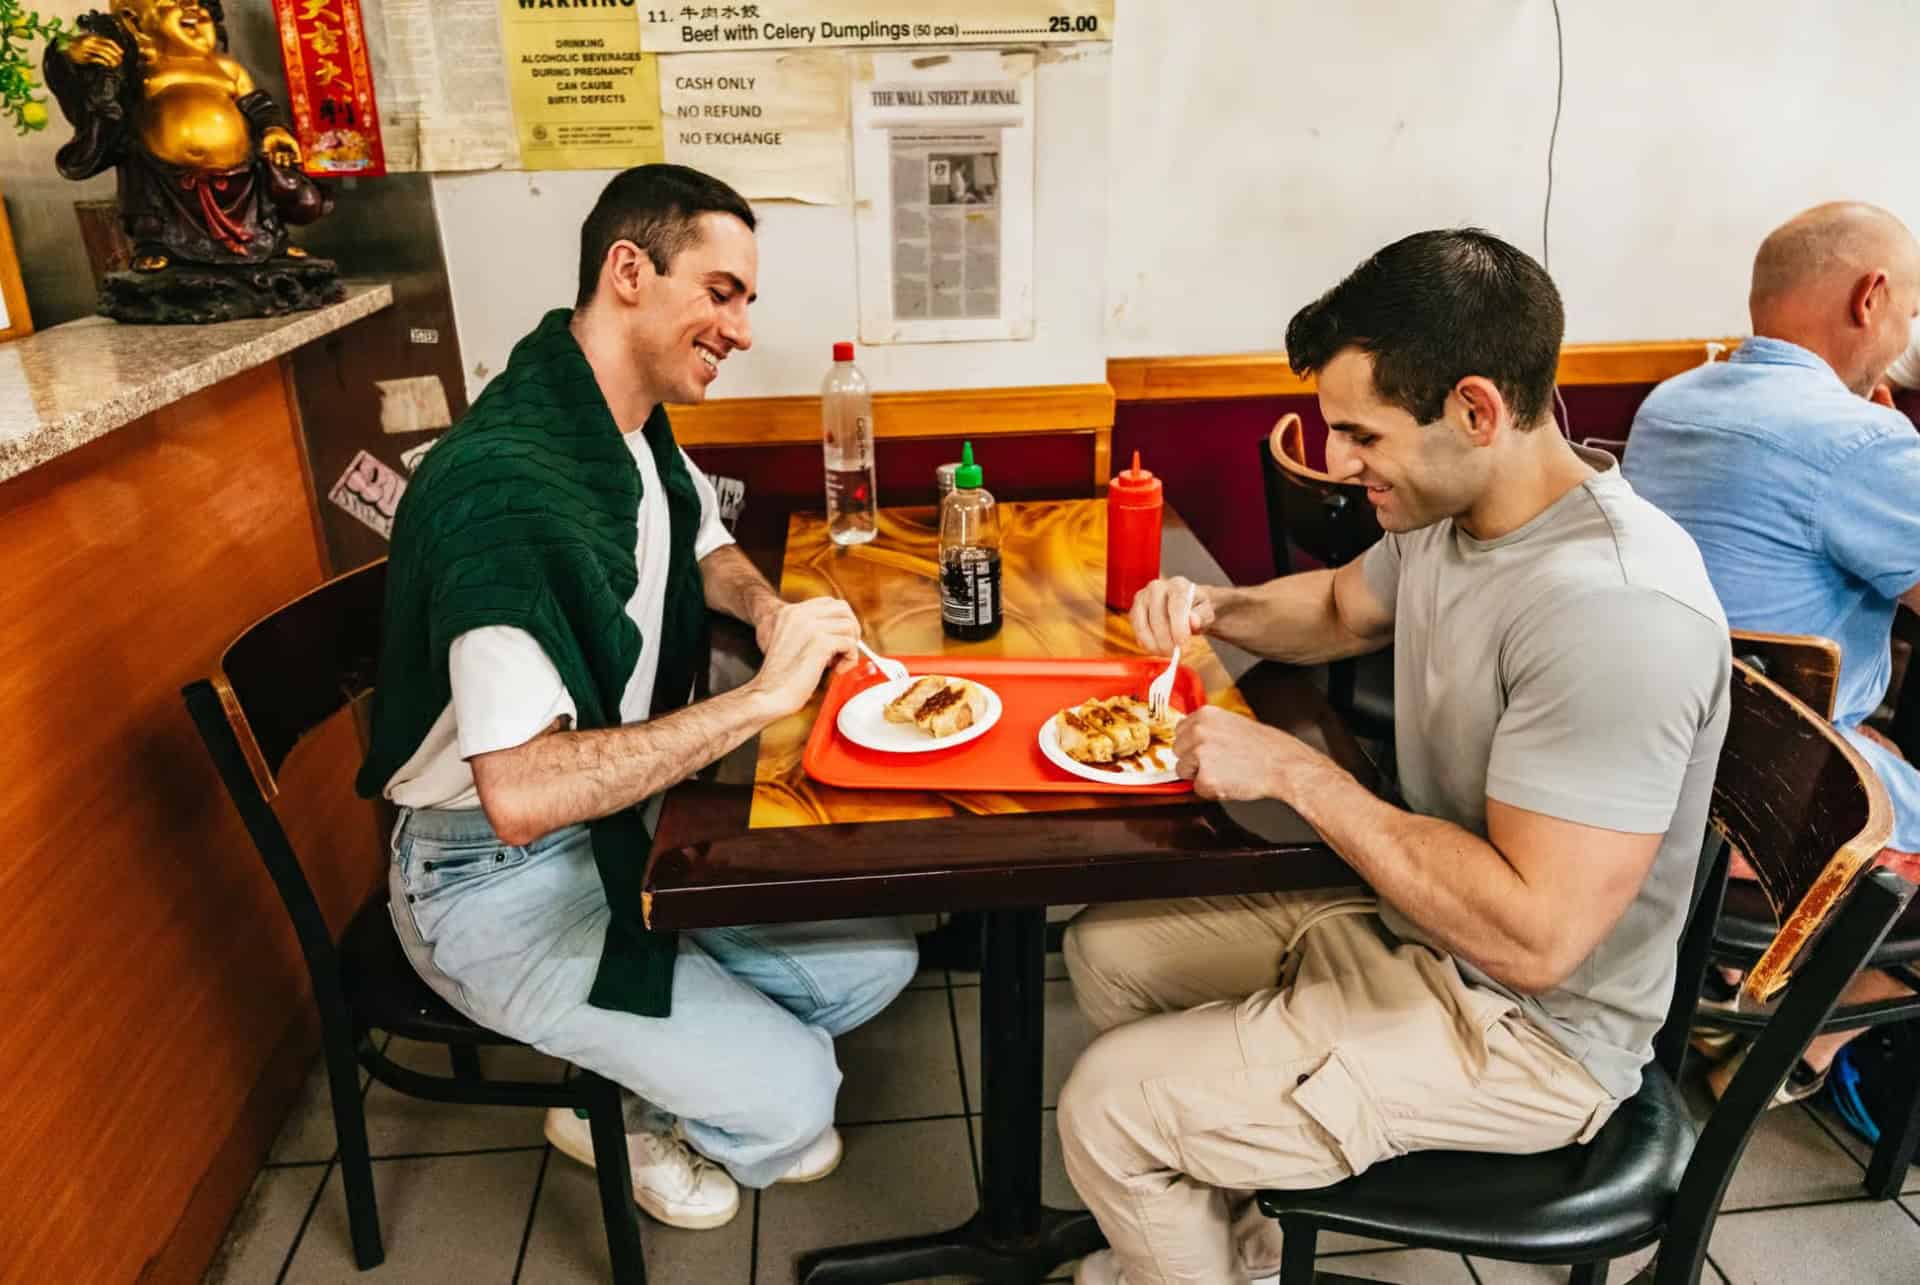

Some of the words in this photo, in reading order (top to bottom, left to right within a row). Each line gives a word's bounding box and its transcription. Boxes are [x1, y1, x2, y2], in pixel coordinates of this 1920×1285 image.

[648, 10, 674, 23] 11.
[682, 25, 719, 42] Beef
[724, 24, 758, 41] with
[763, 22, 816, 41] Celery
[820, 21, 910, 41] Dumplings
[913, 24, 932, 37] (50
[934, 24, 960, 38] pcs)
[1049, 15, 1098, 33] 25.00
[556, 38, 605, 48] DRINKING
[522, 53, 579, 63] ALCOHOLIC
[582, 51, 642, 62] BEVERAGES
[532, 67, 571, 77] DURING
[573, 66, 634, 77] PREGNANCY
[556, 82, 578, 91] CAN
[580, 81, 614, 90] CAUSE
[676, 77, 713, 90] CASH
[717, 77, 756, 89] ONLY
[547, 96, 578, 105] BIRTH
[580, 94, 626, 104] DEFECTS
[872, 91, 895, 107] THE
[896, 90, 925, 106] WALL
[928, 89, 969, 106] STREET
[677, 105, 700, 118] NO
[704, 105, 762, 118] REFUND
[679, 132, 702, 145] NO
[706, 132, 783, 145] EXCHANGE
